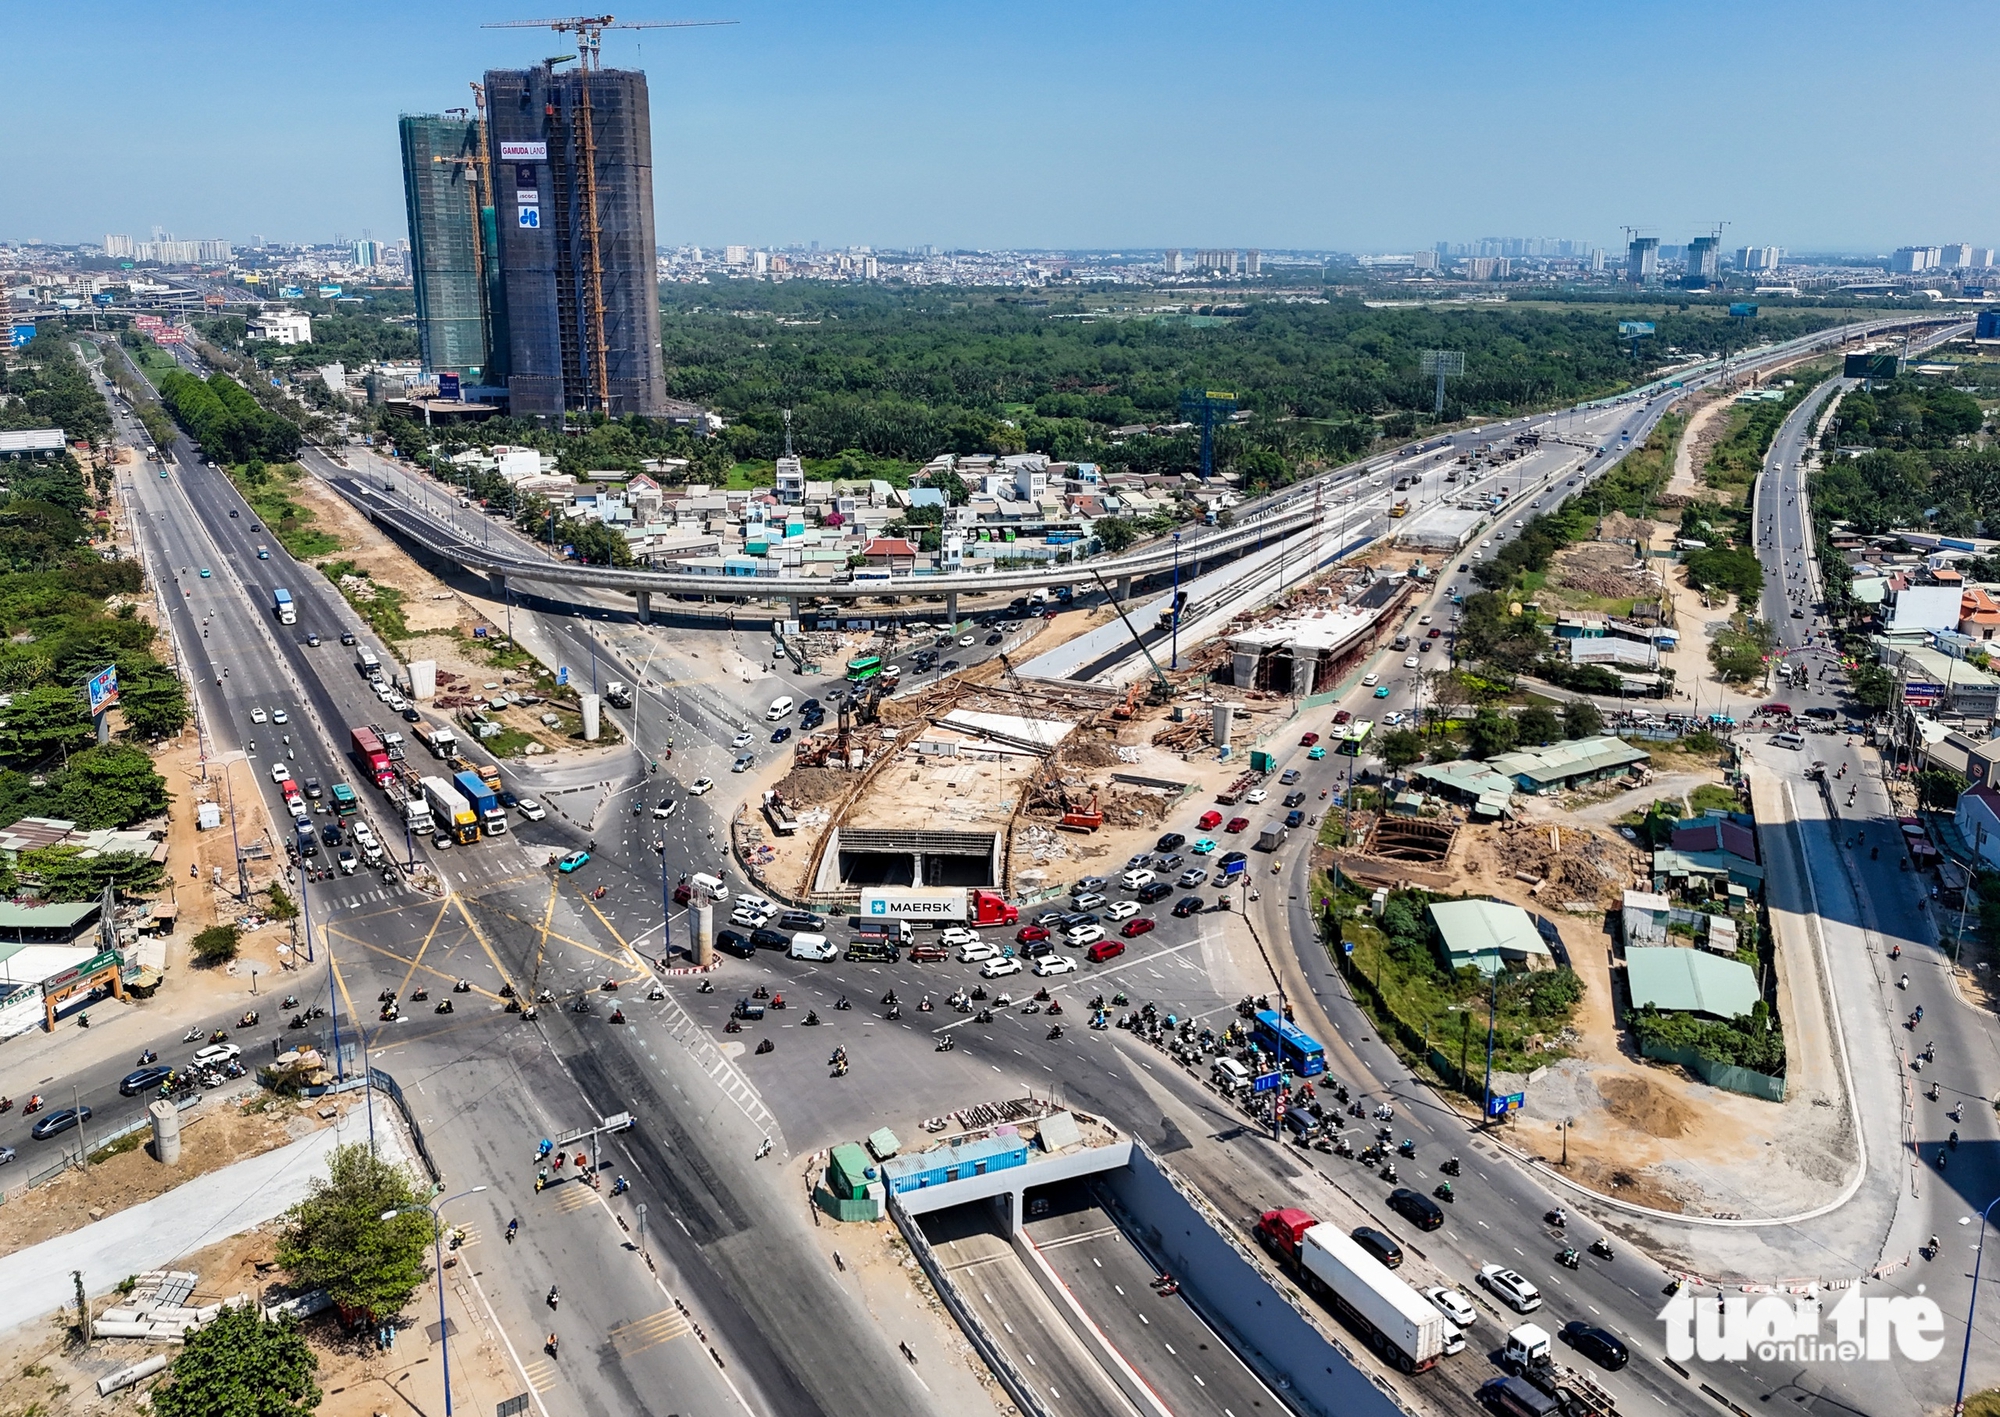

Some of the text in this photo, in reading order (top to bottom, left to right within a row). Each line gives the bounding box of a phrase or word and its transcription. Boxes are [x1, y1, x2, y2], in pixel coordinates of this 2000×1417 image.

[502, 146, 546, 155] GAMUDA LAND
[890, 902, 952, 912] MAERSK
[56, 970, 79, 984] Castrol
